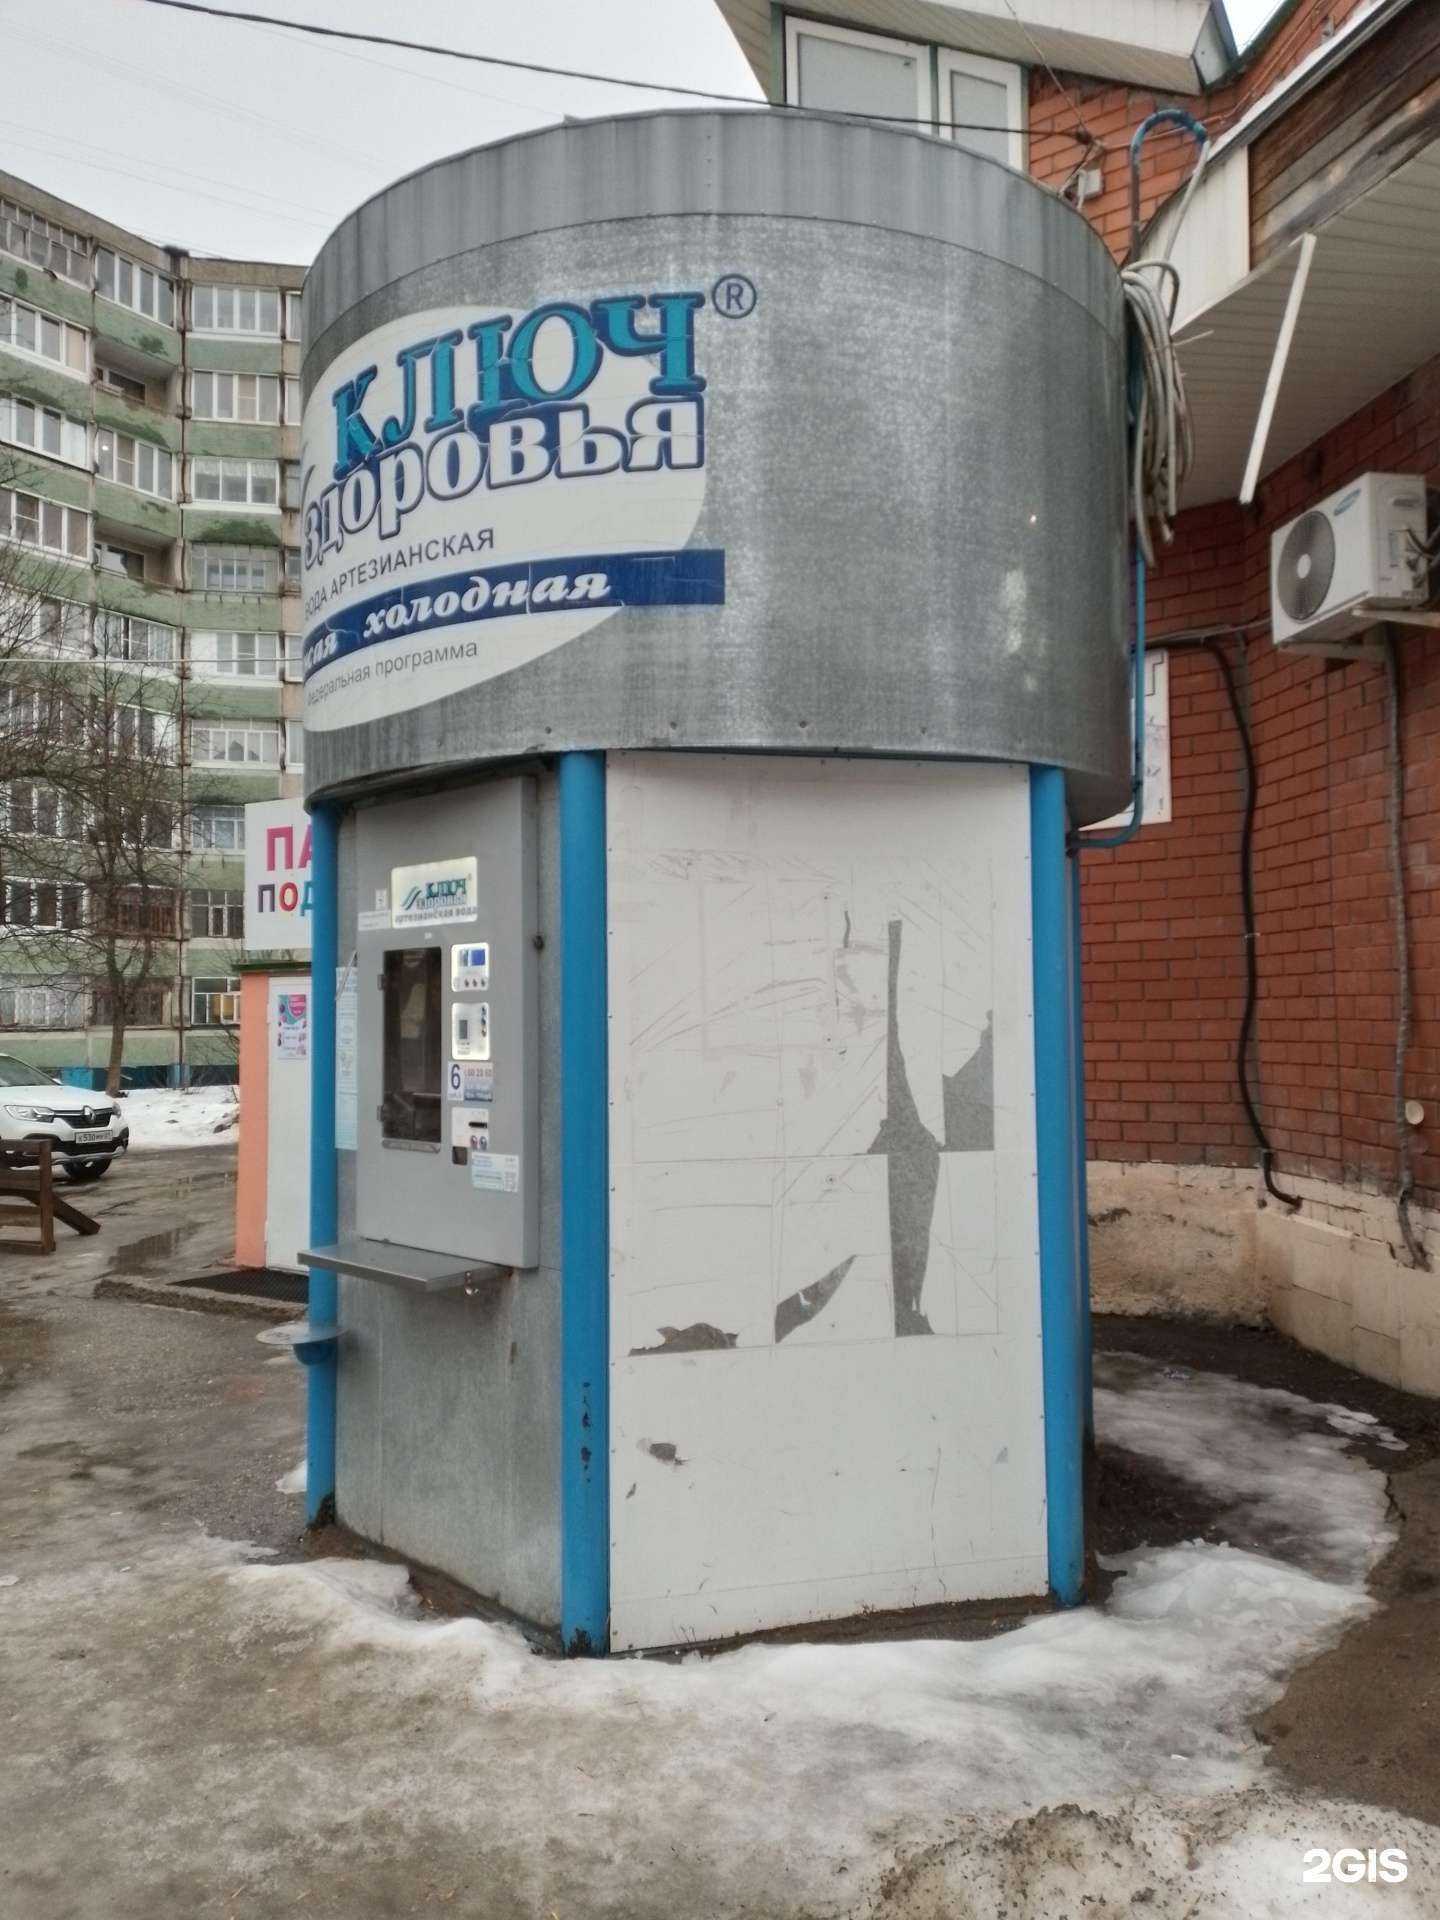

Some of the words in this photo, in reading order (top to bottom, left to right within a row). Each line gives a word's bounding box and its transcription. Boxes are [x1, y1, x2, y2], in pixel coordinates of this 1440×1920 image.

[332, 291, 706, 480] КЛЮЧ
[329, 528, 495, 601] АРТЕЗИАНСКАЯ
[363, 573, 612, 638] холодная
[376, 641, 478, 680] программа
